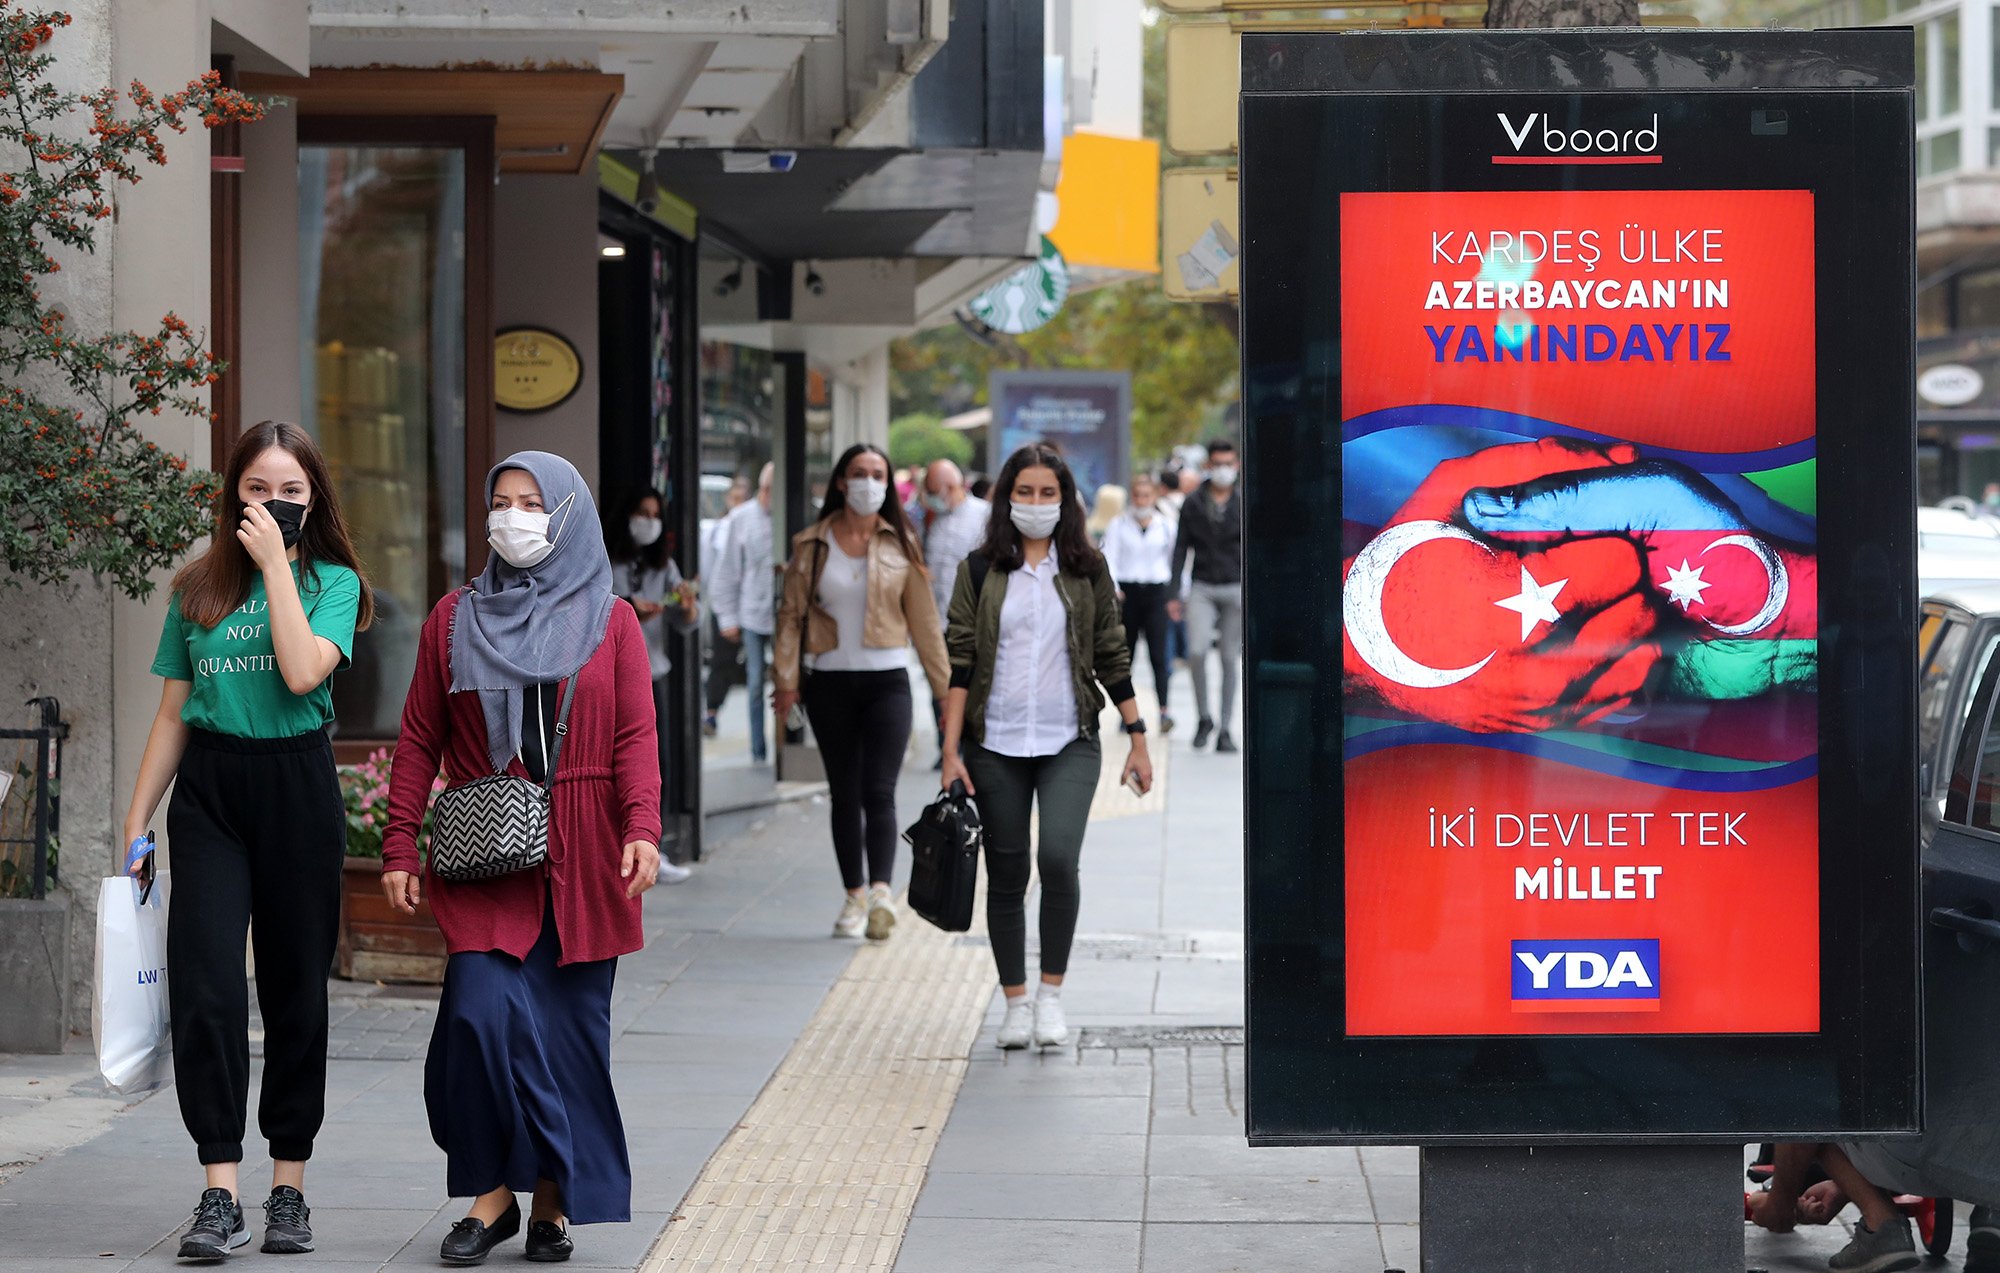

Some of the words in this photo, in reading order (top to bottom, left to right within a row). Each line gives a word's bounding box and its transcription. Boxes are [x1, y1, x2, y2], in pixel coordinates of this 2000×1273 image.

[1496, 112, 1658, 153] Vboard
[1431, 229, 1602, 273] KARDEŞ
[1619, 223, 1723, 263] ÜLKE
[1423, 279, 1730, 310] AZERBAYCAN'IN
[1423, 323, 1731, 363] YANINDAYIZ
[226, 623, 265, 641] NOT
[198, 654, 276, 678] QUANTIT
[1429, 806, 1476, 848] İKİ
[1495, 812, 1655, 847] DEVLET
[1671, 812, 1748, 846] TEK
[1515, 857, 1664, 901] MİLLET
[1515, 951, 1653, 989] YDA
